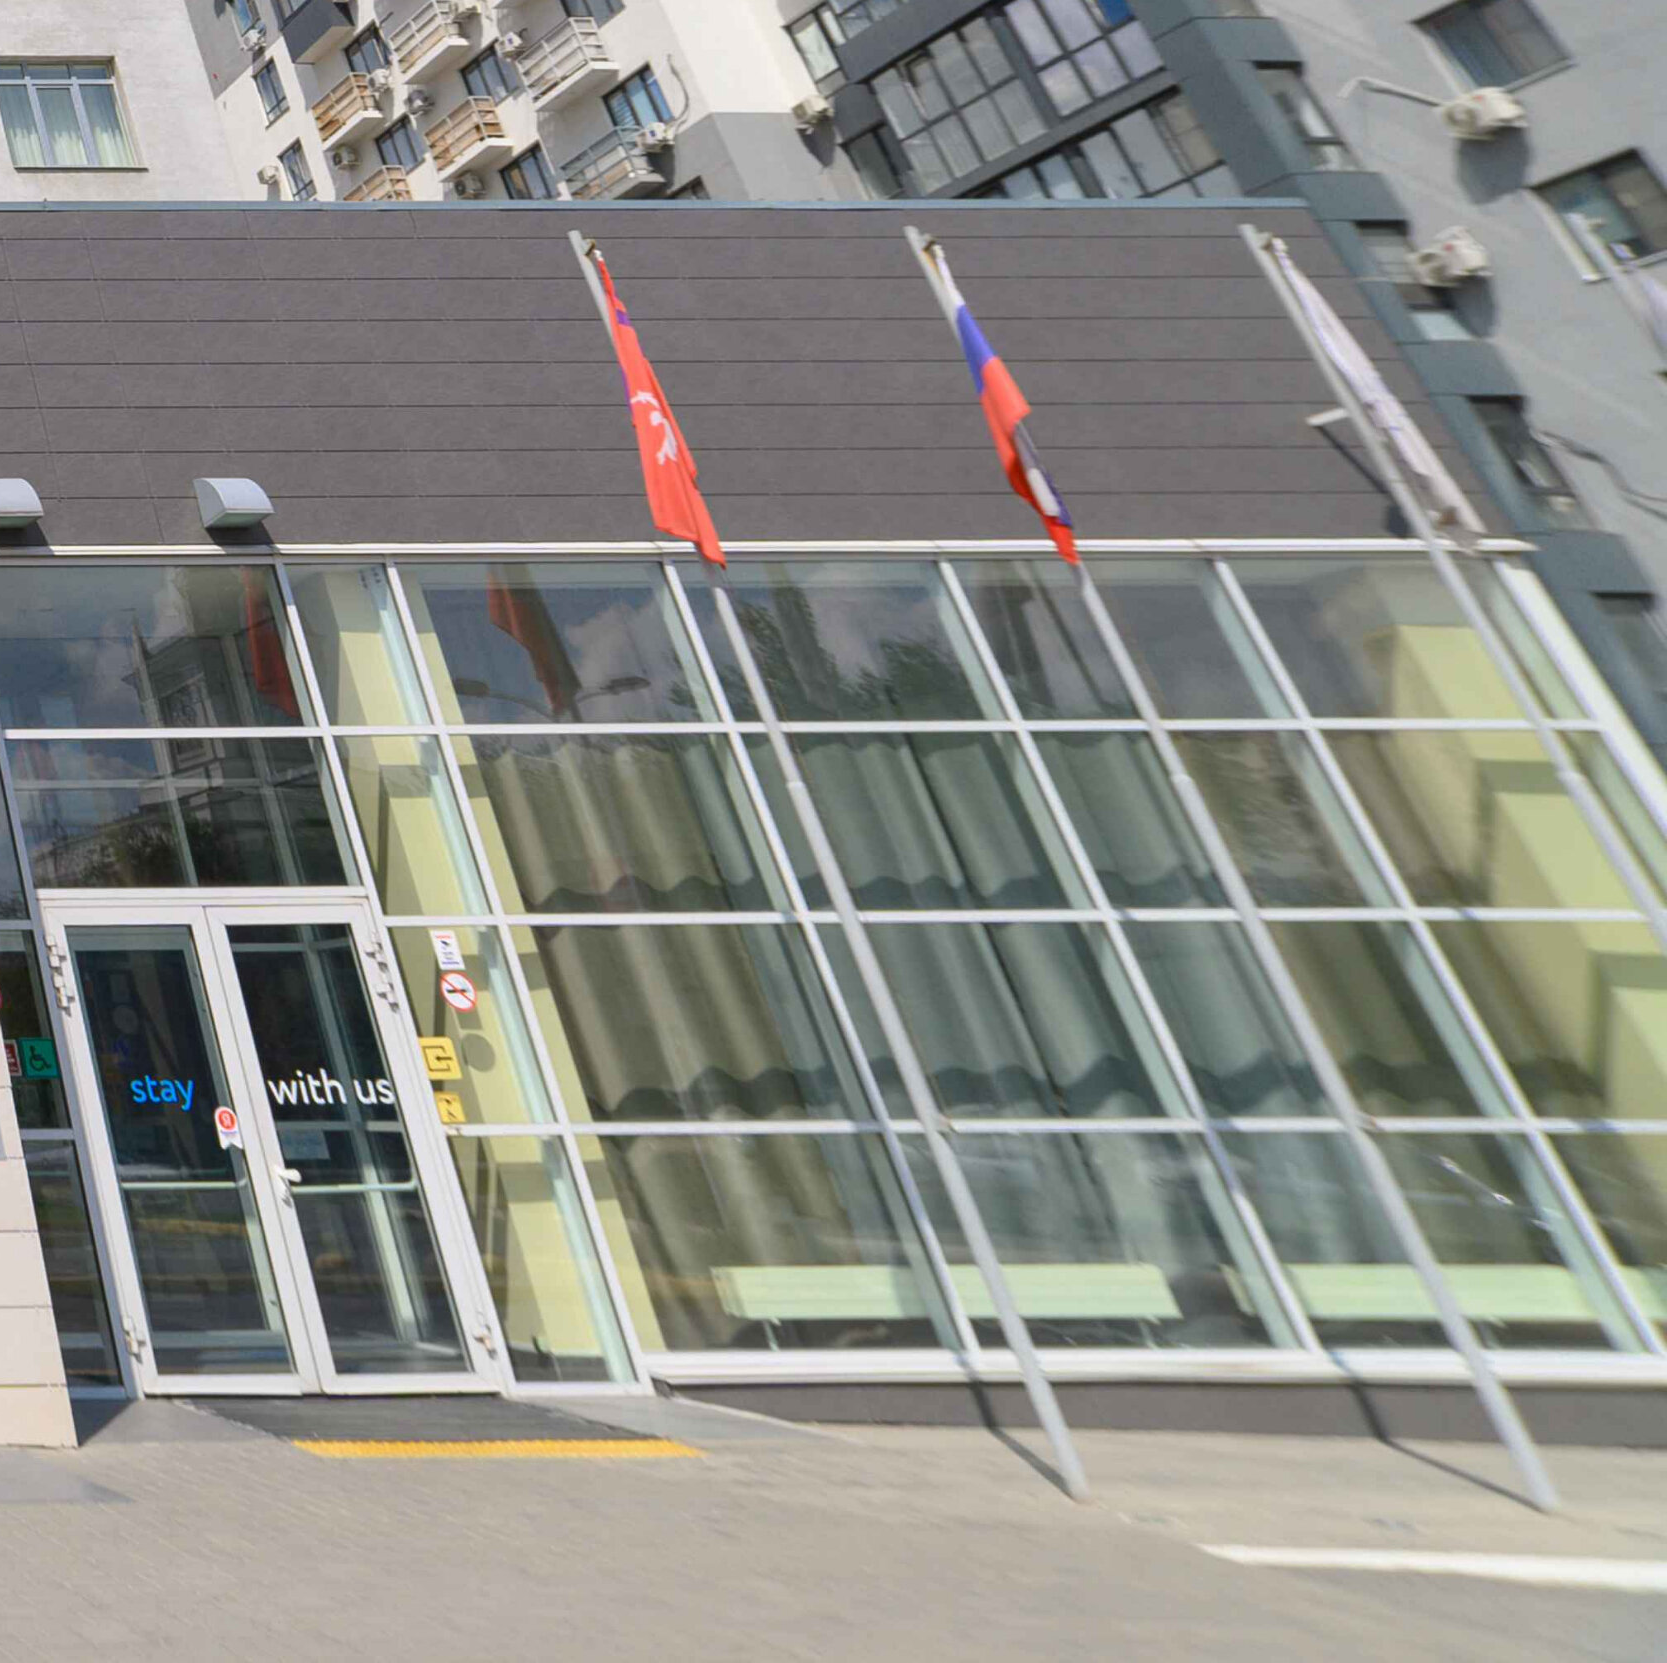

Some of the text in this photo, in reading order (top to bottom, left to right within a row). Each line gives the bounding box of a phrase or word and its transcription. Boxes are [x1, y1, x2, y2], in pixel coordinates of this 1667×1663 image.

[131, 1068, 396, 1111] stay with us
